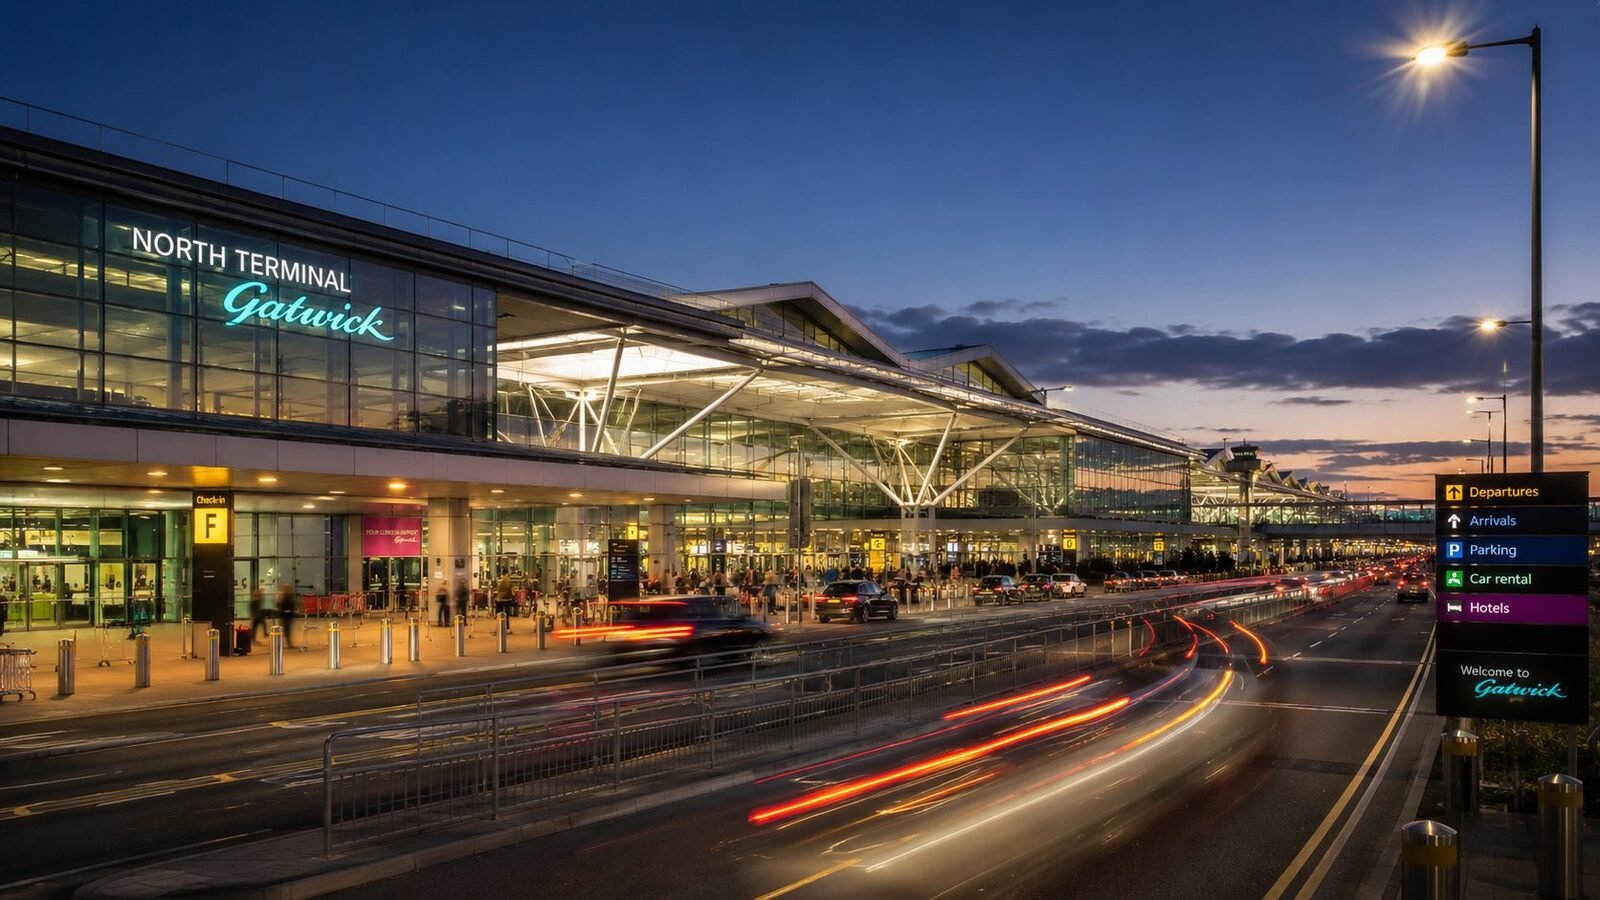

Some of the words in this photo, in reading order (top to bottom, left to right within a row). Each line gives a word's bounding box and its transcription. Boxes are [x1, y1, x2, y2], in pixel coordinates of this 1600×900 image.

[132, 227, 226, 268] NORTH
[235, 249, 351, 293] TERMINAL
[223, 281, 394, 342] Gatwick
[1469, 486, 1539, 498] Departures
[196, 495, 226, 505] Check-in
[205, 513, 217, 539] F
[1469, 514, 1517, 527] Arrivals
[1470, 544, 1517, 558] Parking
[1470, 573, 1492, 585] Car
[1495, 573, 1532, 585] rental
[1470, 602, 1510, 614] Hotels
[1460, 665, 1514, 678] Welcome
[1516, 667, 1530, 679] to
[1474, 678, 1567, 699] Gatwick
